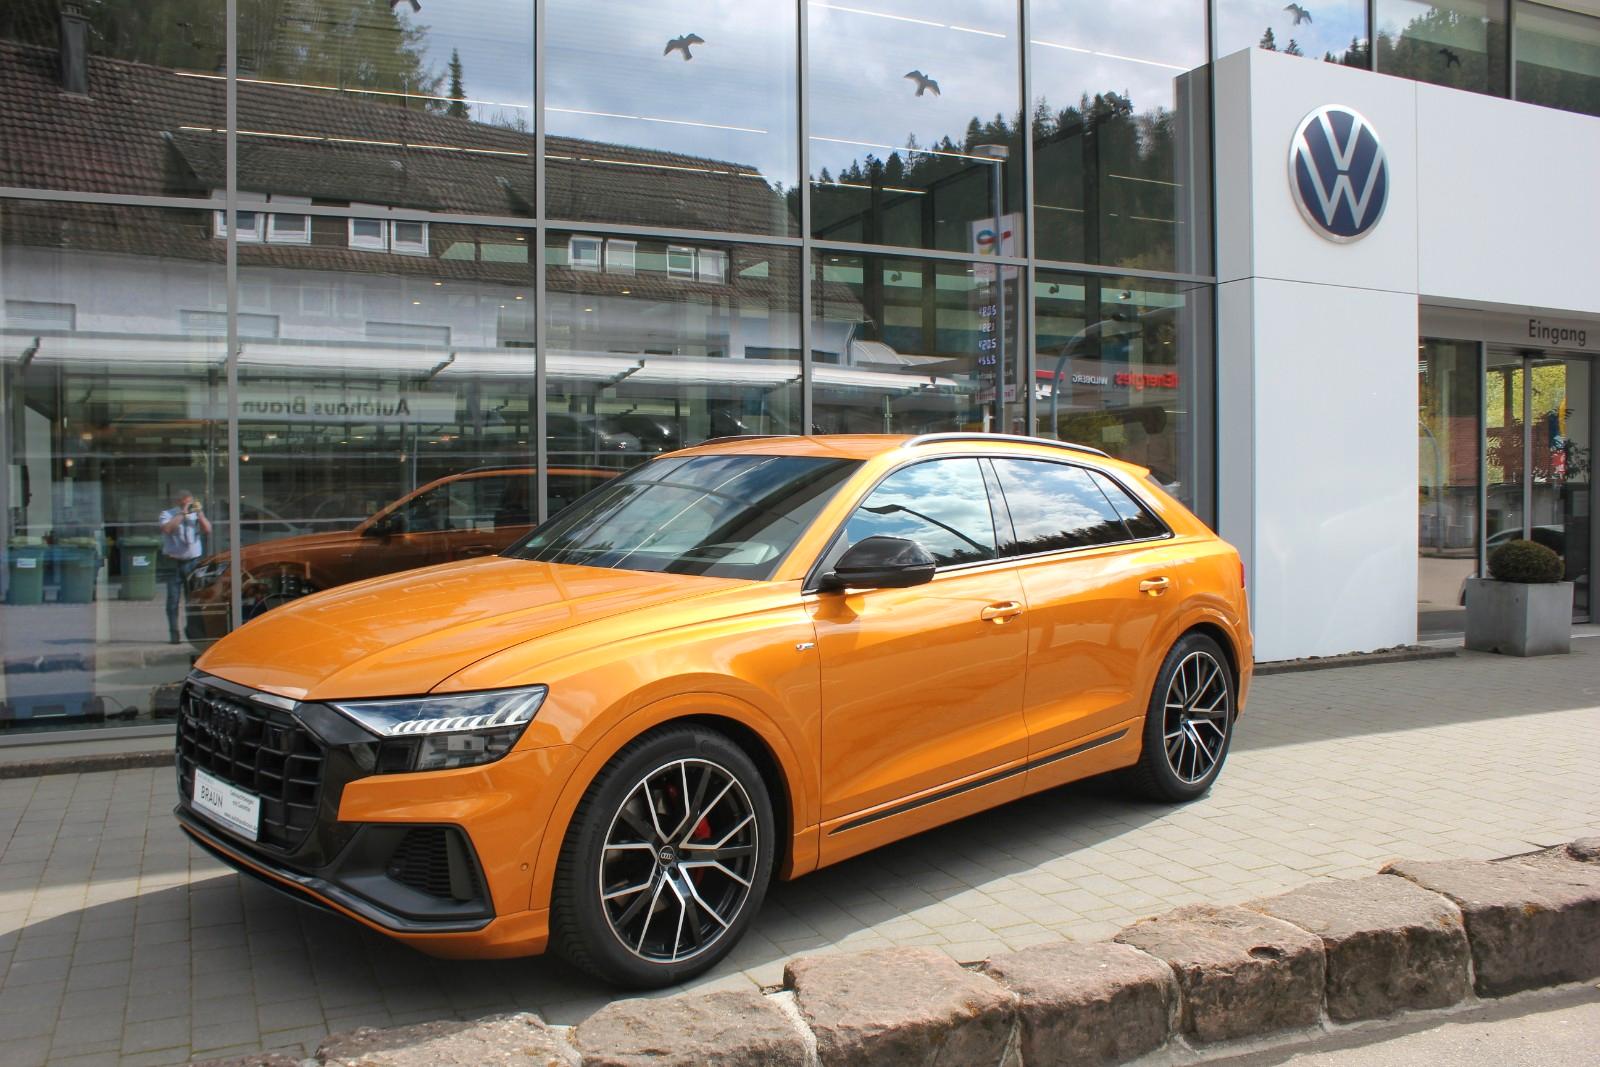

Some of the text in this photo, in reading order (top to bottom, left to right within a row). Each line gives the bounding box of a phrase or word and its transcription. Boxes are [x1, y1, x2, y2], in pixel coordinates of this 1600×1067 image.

[1296, 108, 1386, 231] VW
[1528, 319, 1587, 347] Eingang
[200, 785, 224, 809] BRAUN
